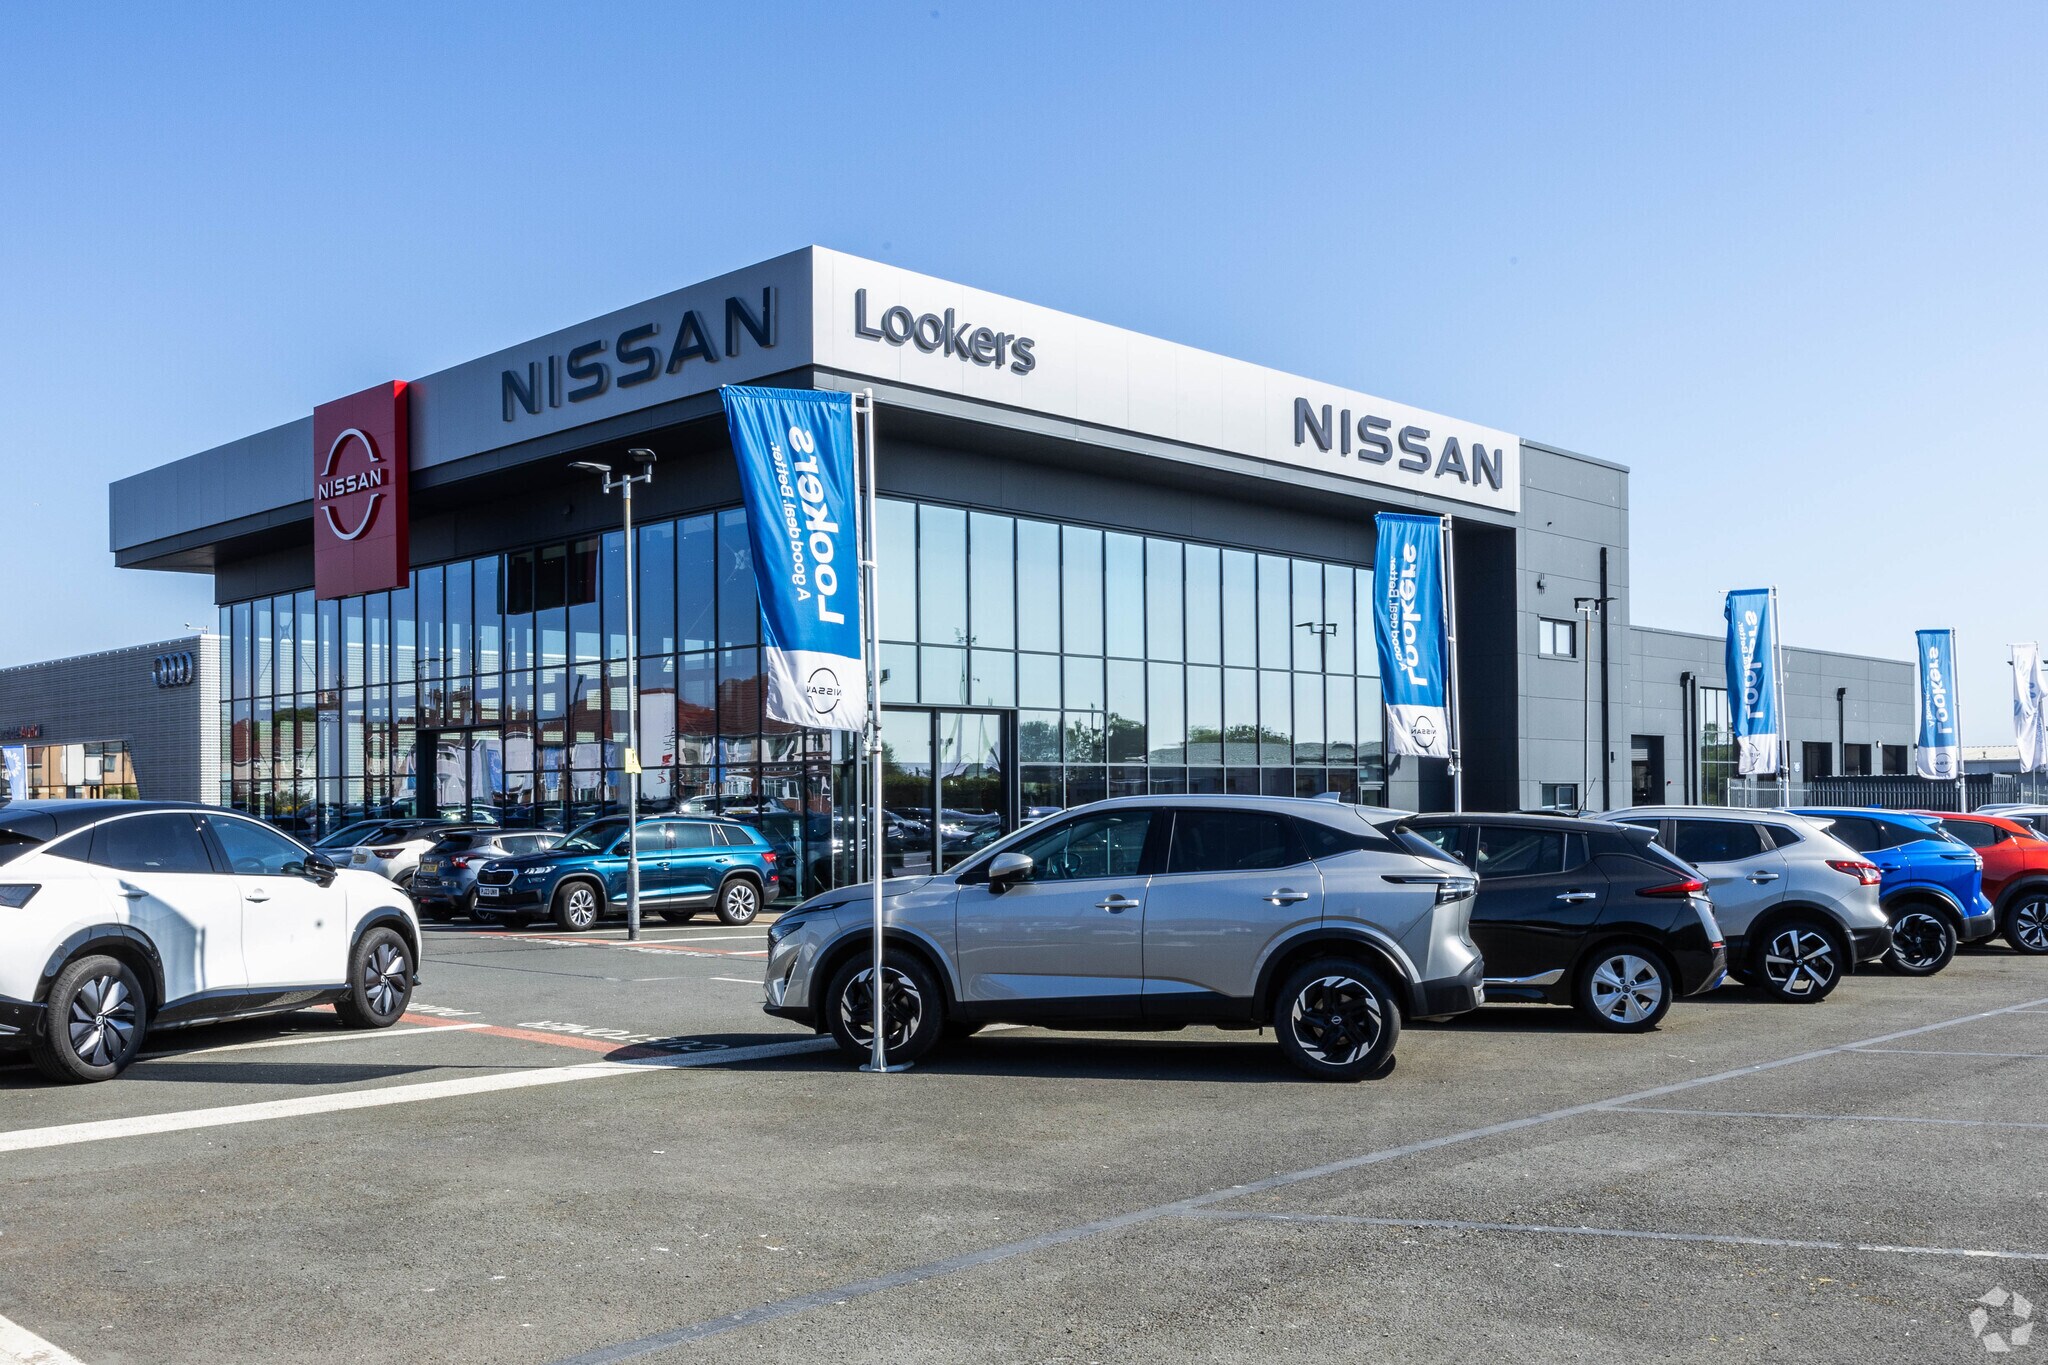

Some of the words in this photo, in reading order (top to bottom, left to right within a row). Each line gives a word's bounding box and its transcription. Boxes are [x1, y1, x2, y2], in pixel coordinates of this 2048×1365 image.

[502, 285, 775, 422] NISSAN
[854, 287, 1036, 376] Lookers
[318, 467, 382, 500] NISSAN
[1294, 396, 1503, 492] NISSAN
